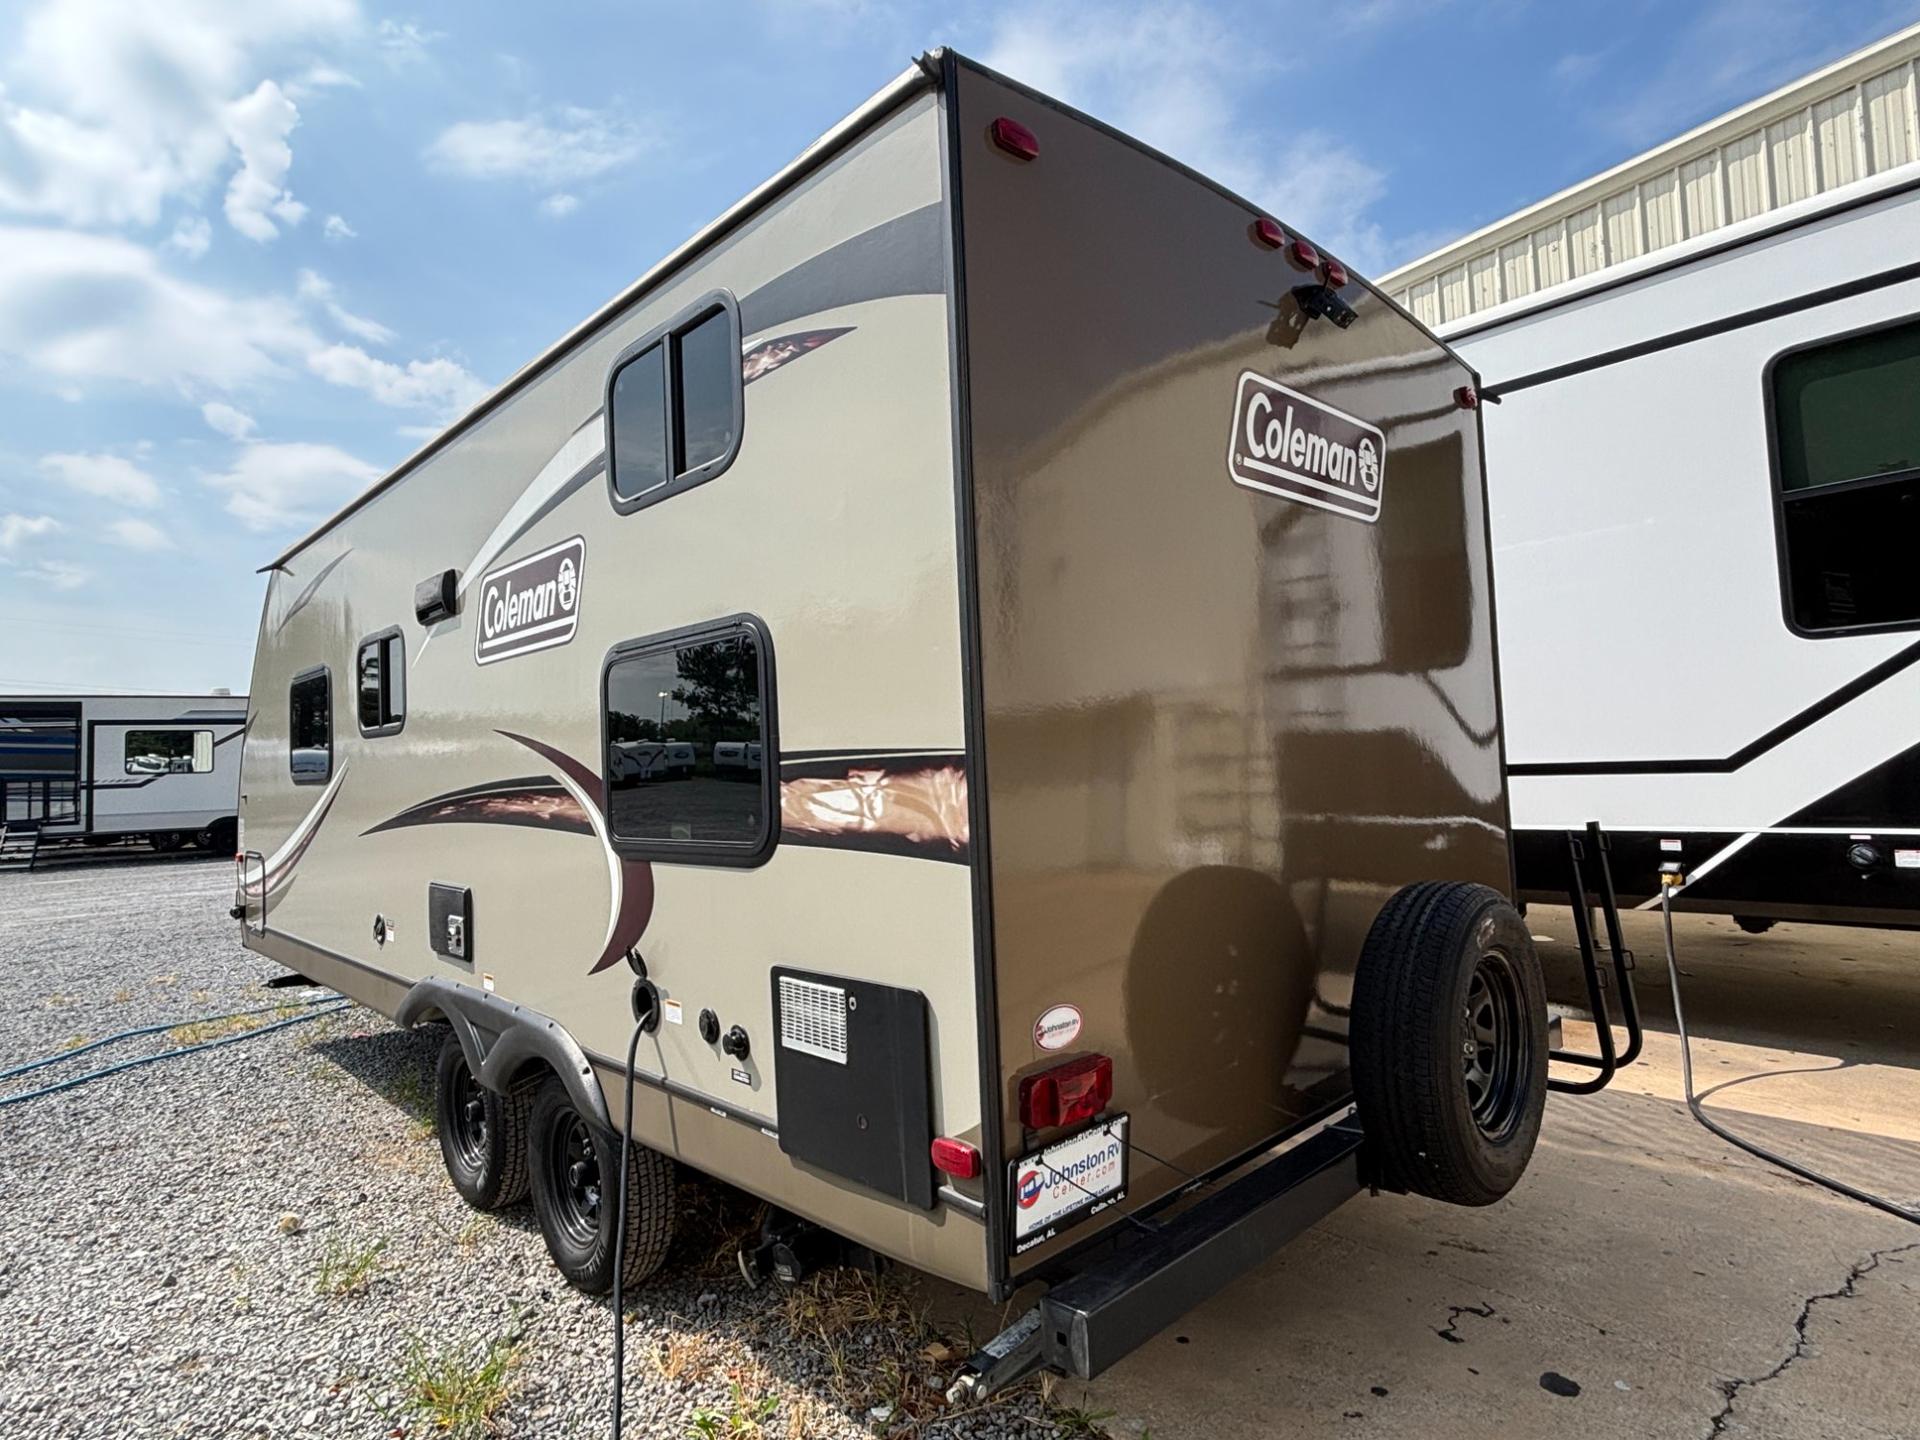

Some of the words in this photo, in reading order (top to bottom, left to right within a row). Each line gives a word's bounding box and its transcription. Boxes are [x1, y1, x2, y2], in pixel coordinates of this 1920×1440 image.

[1246, 391, 1357, 486] Coleman
[484, 580, 557, 638] Coleman
[1045, 1150, 1106, 1189] Johnston
[1107, 1142, 1121, 1161] RV
[1053, 1161, 1116, 1199] Center.com
[1028, 1218, 1044, 1231] HOME
[1044, 1214, 1052, 1223] OF
[1052, 1208, 1062, 1217] THE
[1063, 1197, 1084, 1214] LIFETIME
[1084, 1185, 1110, 1201] WARANTY
[1117, 1191, 1126, 1201] AL
[1046, 1228, 1056, 1239] AL
